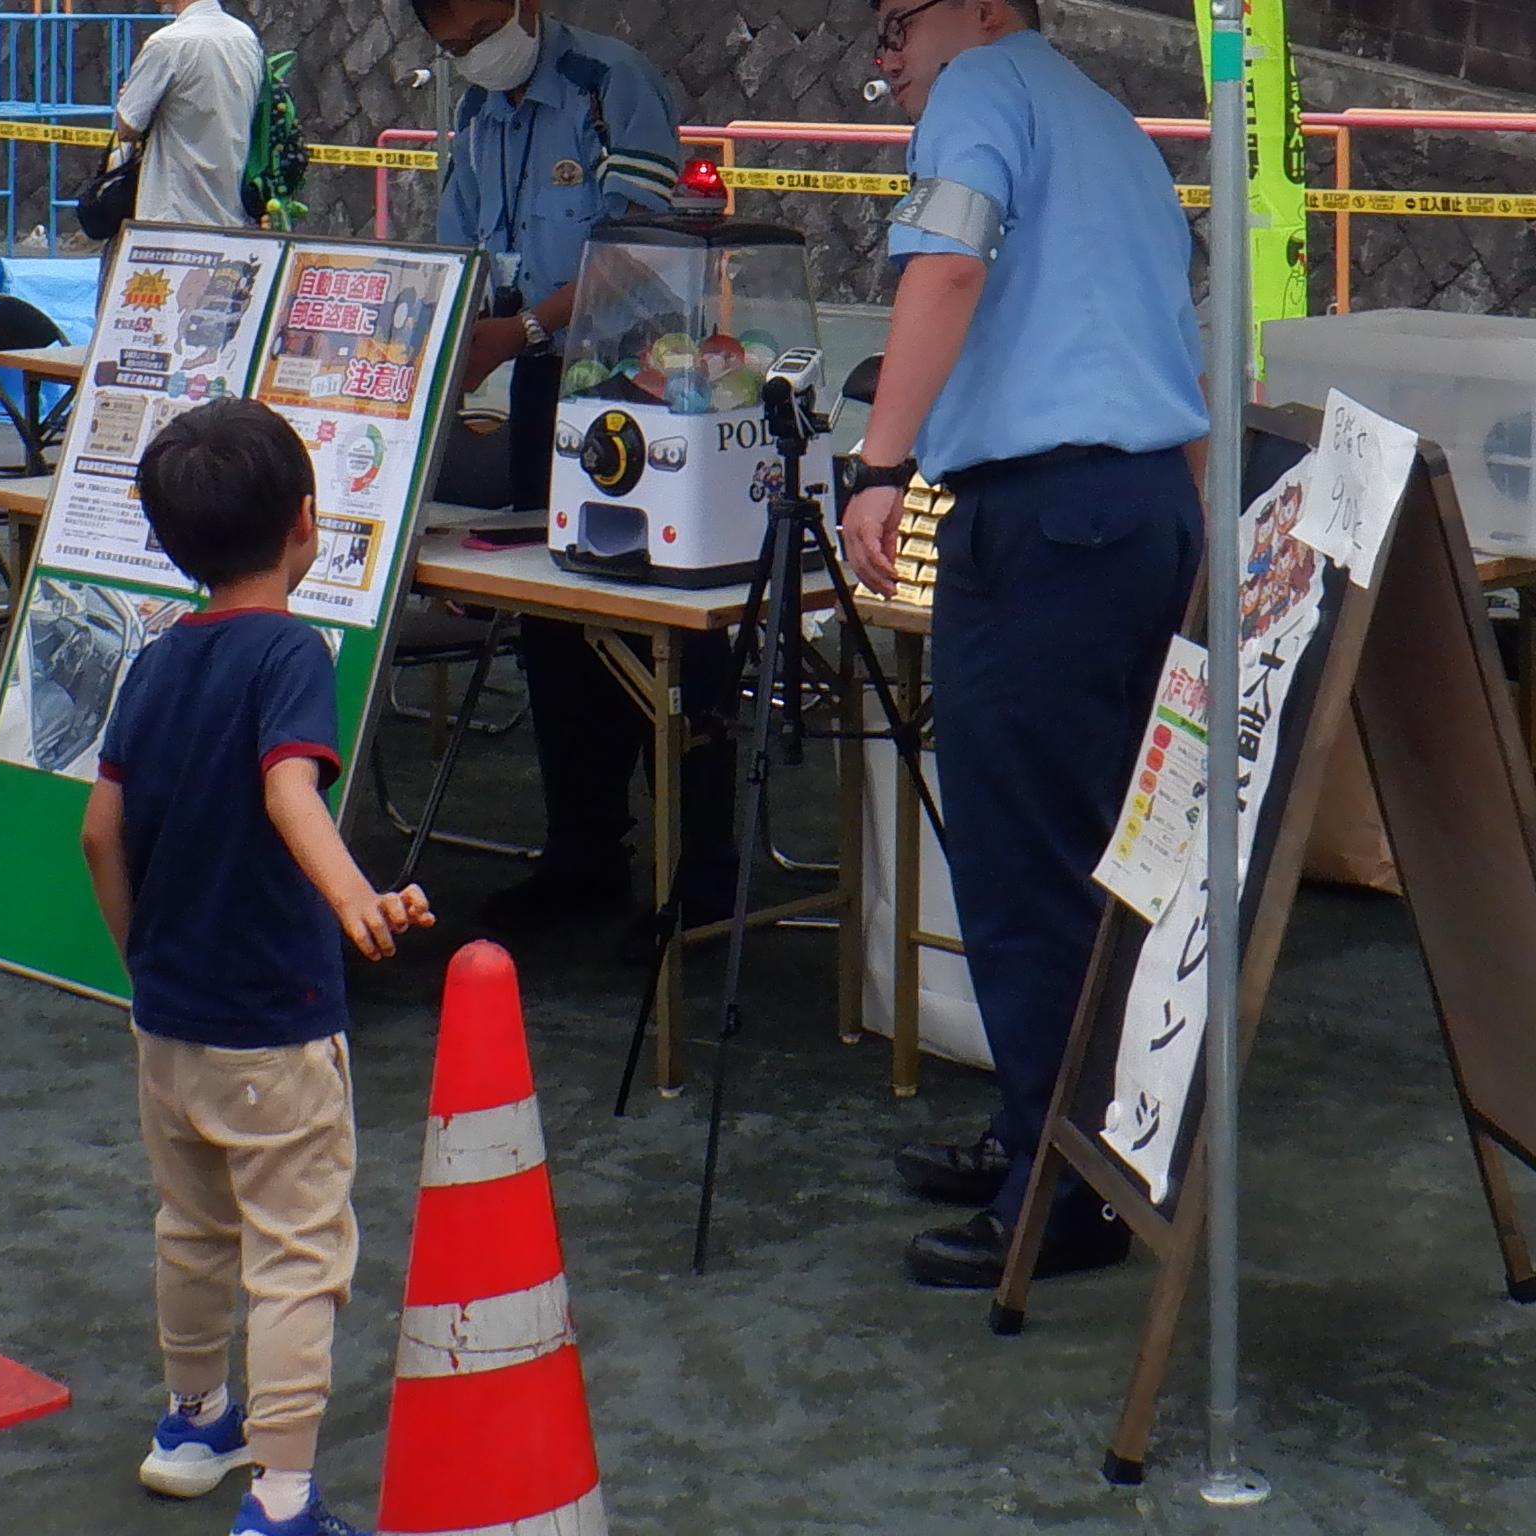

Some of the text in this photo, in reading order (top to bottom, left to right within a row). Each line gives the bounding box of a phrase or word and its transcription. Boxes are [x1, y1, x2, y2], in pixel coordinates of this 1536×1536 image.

[296, 268, 390, 304] 自動車盗難
